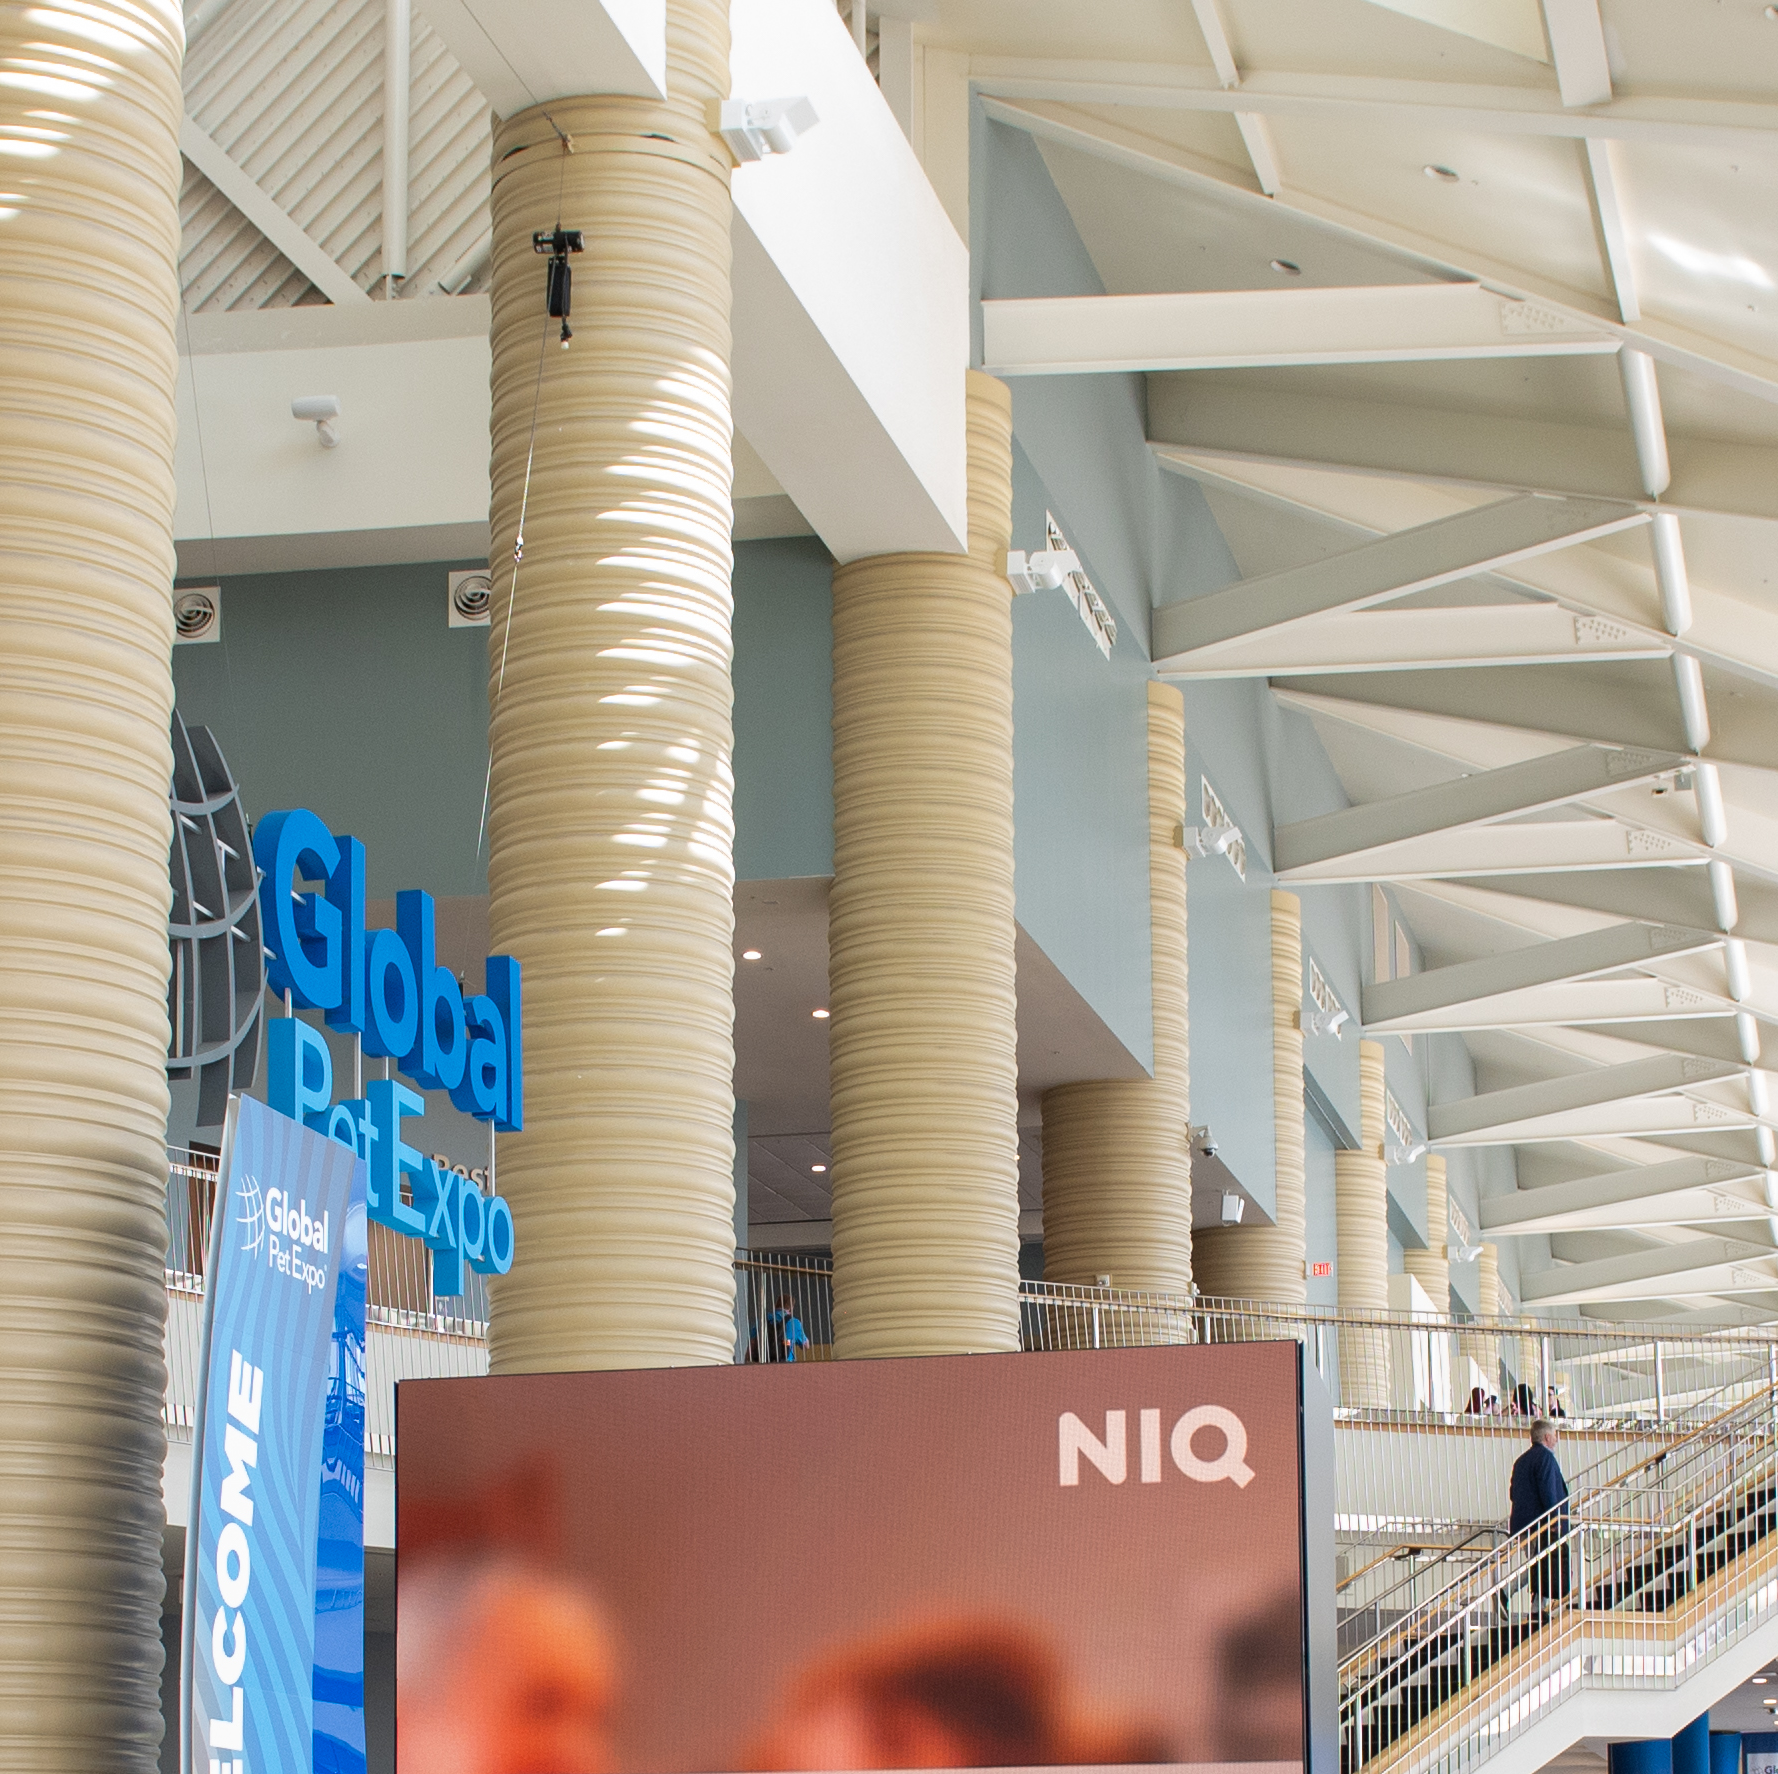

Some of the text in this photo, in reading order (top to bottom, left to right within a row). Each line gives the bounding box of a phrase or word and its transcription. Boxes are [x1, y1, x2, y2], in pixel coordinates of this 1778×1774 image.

[255, 808, 523, 1131] Global
[265, 1187, 329, 1254] Global
[369, 1079, 515, 1296] Expo
[1059, 1404, 1256, 1489] NIQ
